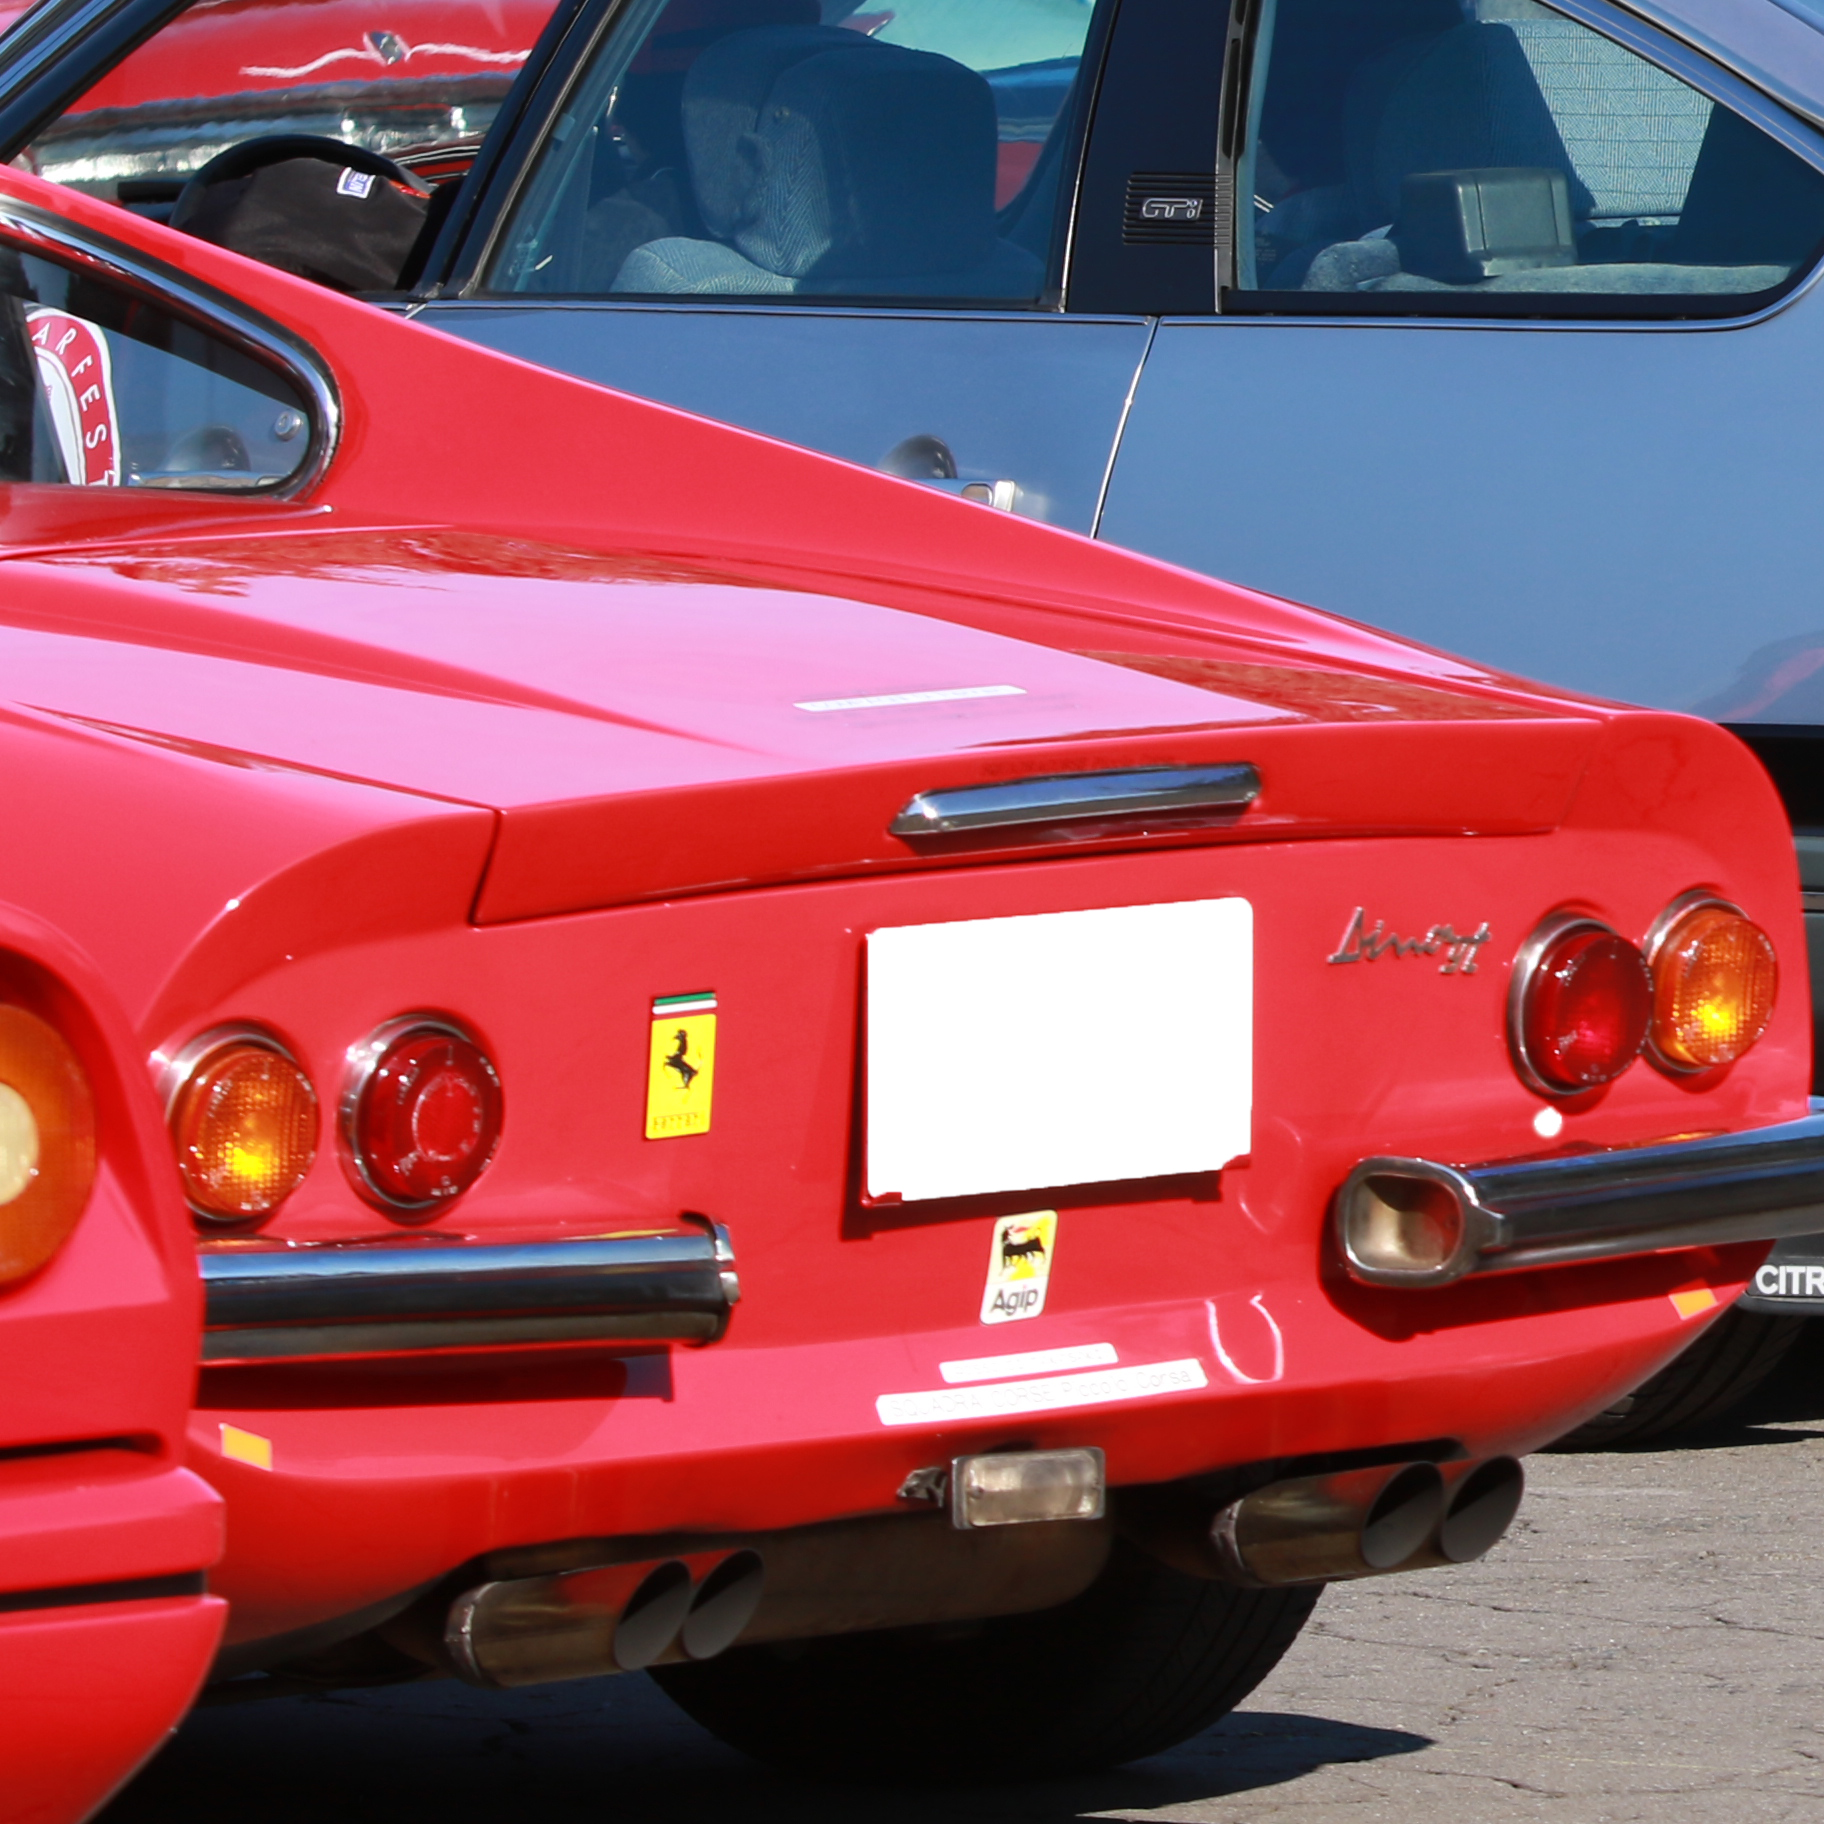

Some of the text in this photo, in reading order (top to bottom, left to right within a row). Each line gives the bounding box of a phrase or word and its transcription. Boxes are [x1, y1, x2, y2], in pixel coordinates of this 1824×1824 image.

[989, 1285, 1039, 1317] Agip
[992, 1381, 1055, 1407] CORSE
[1136, 1366, 1193, 1388] Corsa
